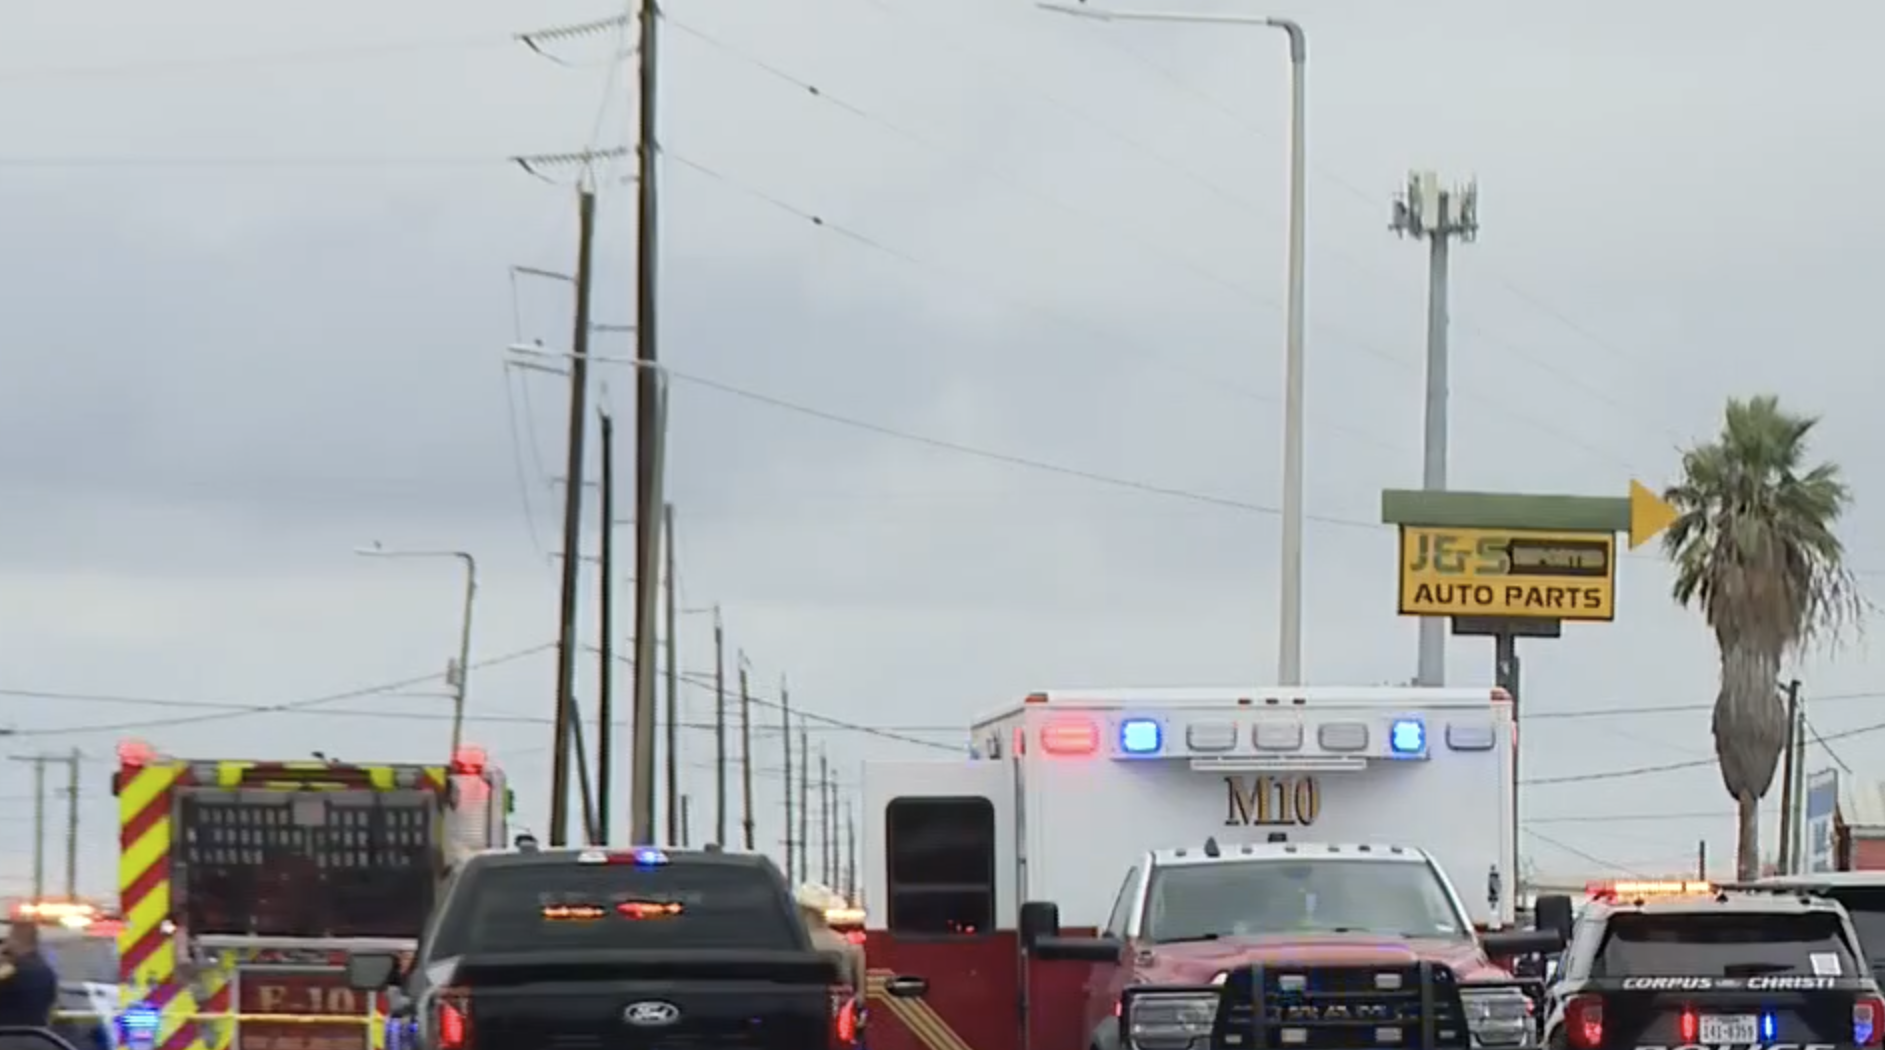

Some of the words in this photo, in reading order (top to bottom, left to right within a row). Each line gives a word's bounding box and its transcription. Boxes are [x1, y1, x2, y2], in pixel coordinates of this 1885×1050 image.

[1413, 583, 1493, 606] AUTO
[1505, 585, 1602, 610] PARTS
[1224, 775, 1321, 826] M10
[1623, 976, 1712, 990] CORPUS
[1747, 976, 1835, 990] CHRISTI
